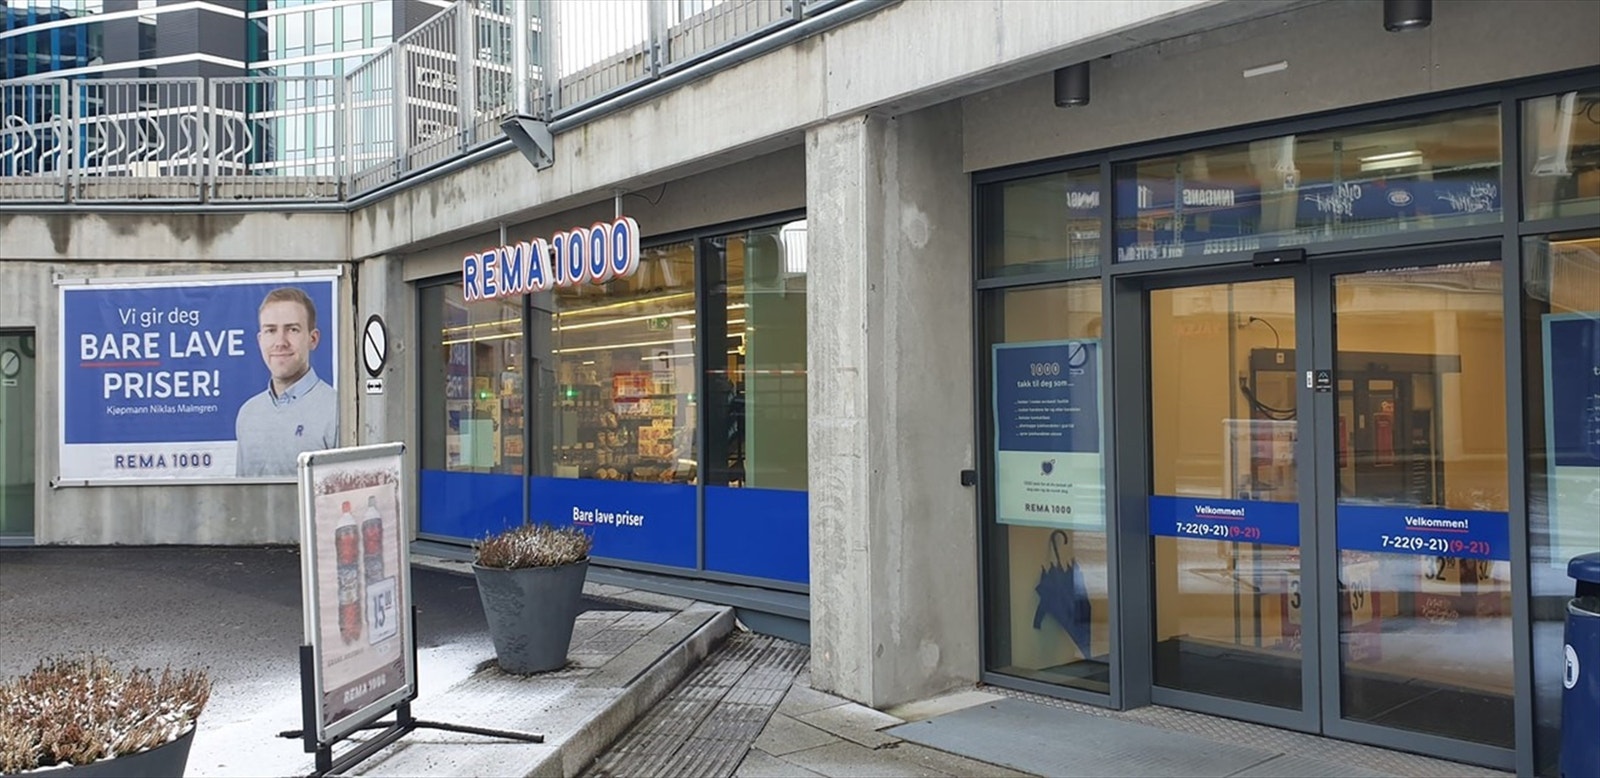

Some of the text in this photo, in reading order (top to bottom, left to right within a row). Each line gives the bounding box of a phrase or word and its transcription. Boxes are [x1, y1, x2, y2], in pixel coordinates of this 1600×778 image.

[463, 216, 637, 301] REMA 1000
[118, 307, 200, 328] Vi gir deg
[80, 329, 245, 360] BARE LAVE
[1030, 362, 1061, 377] 1000
[103, 369, 221, 399] PRISER!
[1017, 380, 1032, 388] takk
[1040, 379, 1053, 389] deg
[106, 402, 218, 416] Kjøpmann Niklas Malmgren
[115, 453, 212, 469] REMA 1000
[573, 506, 643, 527] Bare lave priser
[1025, 503, 1072, 514] REMA 1000
[1194, 504, 1246, 517] Velkommen!
[1405, 516, 1469, 530] Velkommen!
[373, 592, 386, 629] 15
[343, 681, 368, 704] REMA
